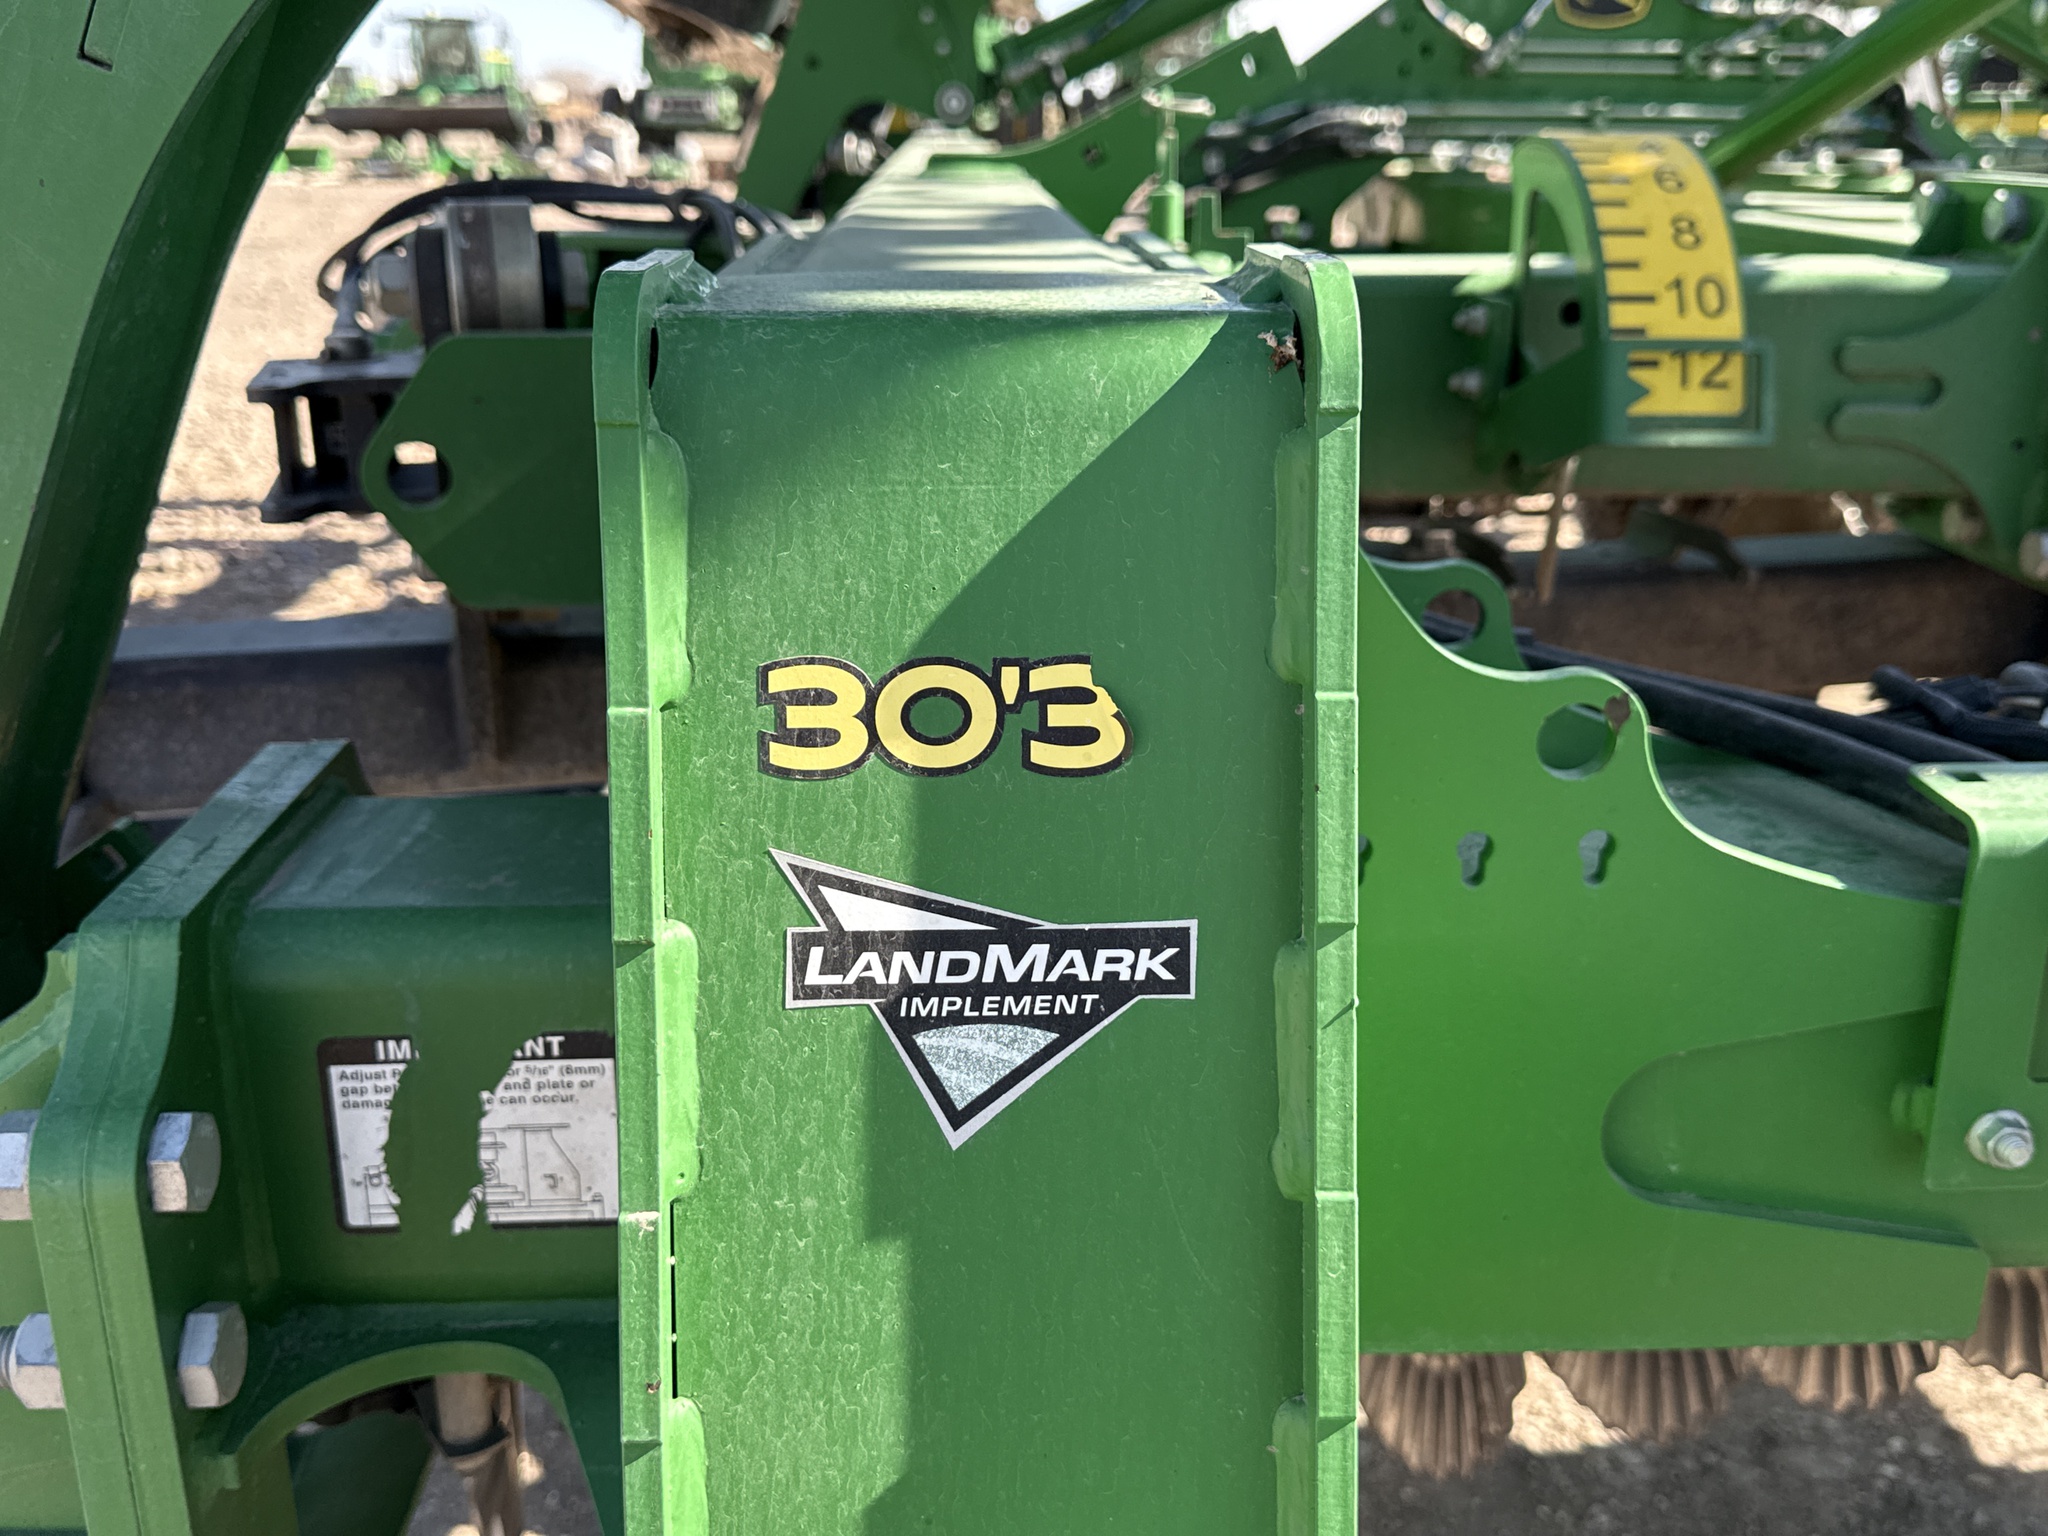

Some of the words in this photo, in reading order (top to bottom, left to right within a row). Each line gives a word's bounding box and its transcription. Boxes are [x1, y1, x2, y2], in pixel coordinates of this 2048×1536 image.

[1653, 164, 1687, 194] 6
[1670, 214, 1703, 251] 8
[1664, 276, 1726, 319] 10
[1671, 351, 1729, 389] 12
[900, 994, 1099, 1018] IMPLEMENT
[340, 1069, 386, 1082] Adjust
[340, 1085, 369, 1098] gap
[503, 1078, 531, 1090] and
[536, 1078, 574, 1091] plate
[579, 1079, 596, 1088] or
[499, 1095, 527, 1105] can
